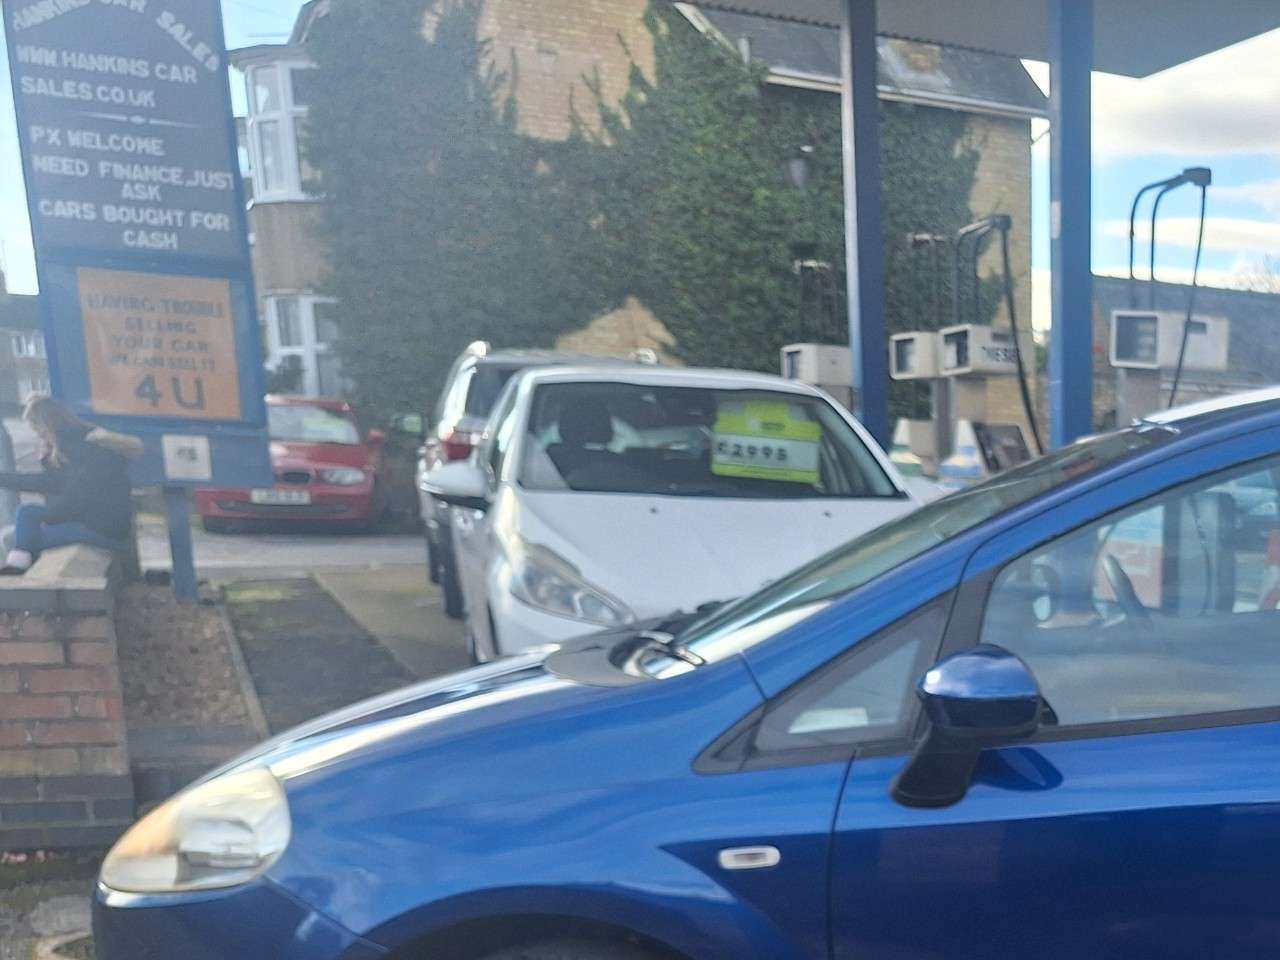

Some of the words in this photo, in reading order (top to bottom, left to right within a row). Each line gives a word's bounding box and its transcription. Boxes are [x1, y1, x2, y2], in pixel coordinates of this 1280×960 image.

[156, 10, 220, 72] SALES
[154, 63, 198, 83] CAR
[29, 126, 61, 146] PX
[66, 129, 165, 156] WELCOME
[32, 154, 89, 178] NEED
[184, 170, 235, 191] JUST
[121, 183, 162, 201] ASK
[38, 199, 97, 221] CARS
[102, 205, 184, 228] BOUGHT
[191, 211, 231, 232] FOR
[123, 230, 179, 250] CASH
[136, 374, 162, 408] 4
[172, 376, 206, 410] U
